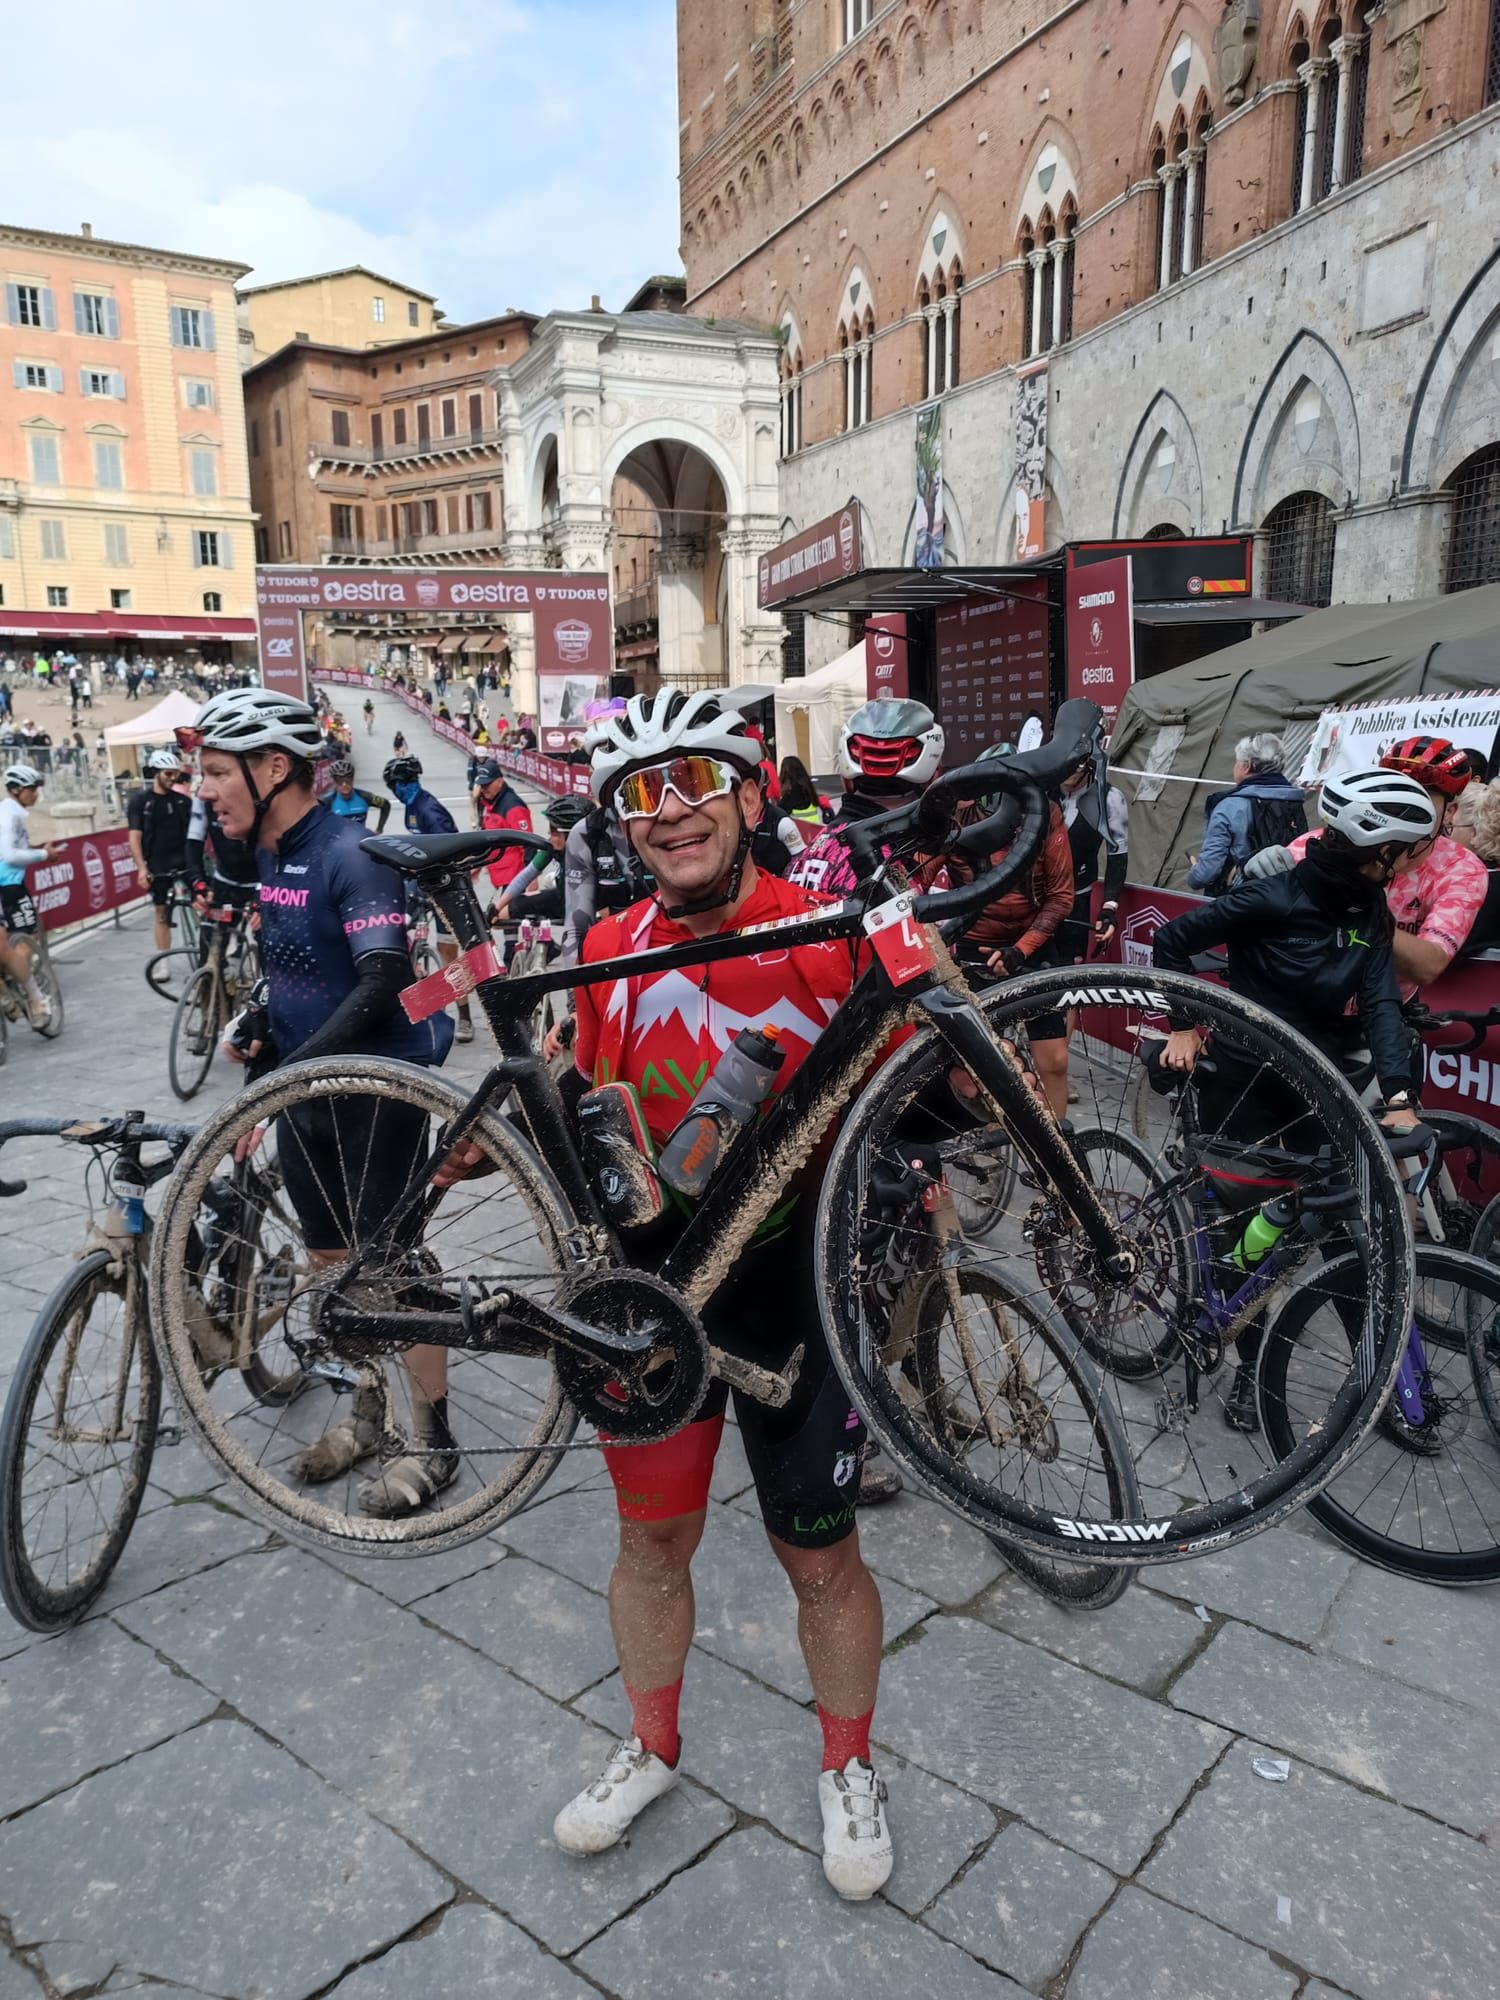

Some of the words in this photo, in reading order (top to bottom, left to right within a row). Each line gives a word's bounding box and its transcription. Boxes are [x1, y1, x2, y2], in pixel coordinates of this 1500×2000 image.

[267, 576, 309, 587] TUDOR
[268, 593, 311, 604] TUDOR
[548, 588, 597, 600] TUDOR
[1078, 589, 1116, 609] SHIMANO
[1350, 711, 1408, 735] Pubblica
[1412, 706, 1500, 729] Assistenza
[1362, 808, 1389, 826] SMITH
[1056, 987, 1173, 1013] MICHE
[1052, 1516, 1172, 1542] MICHE
